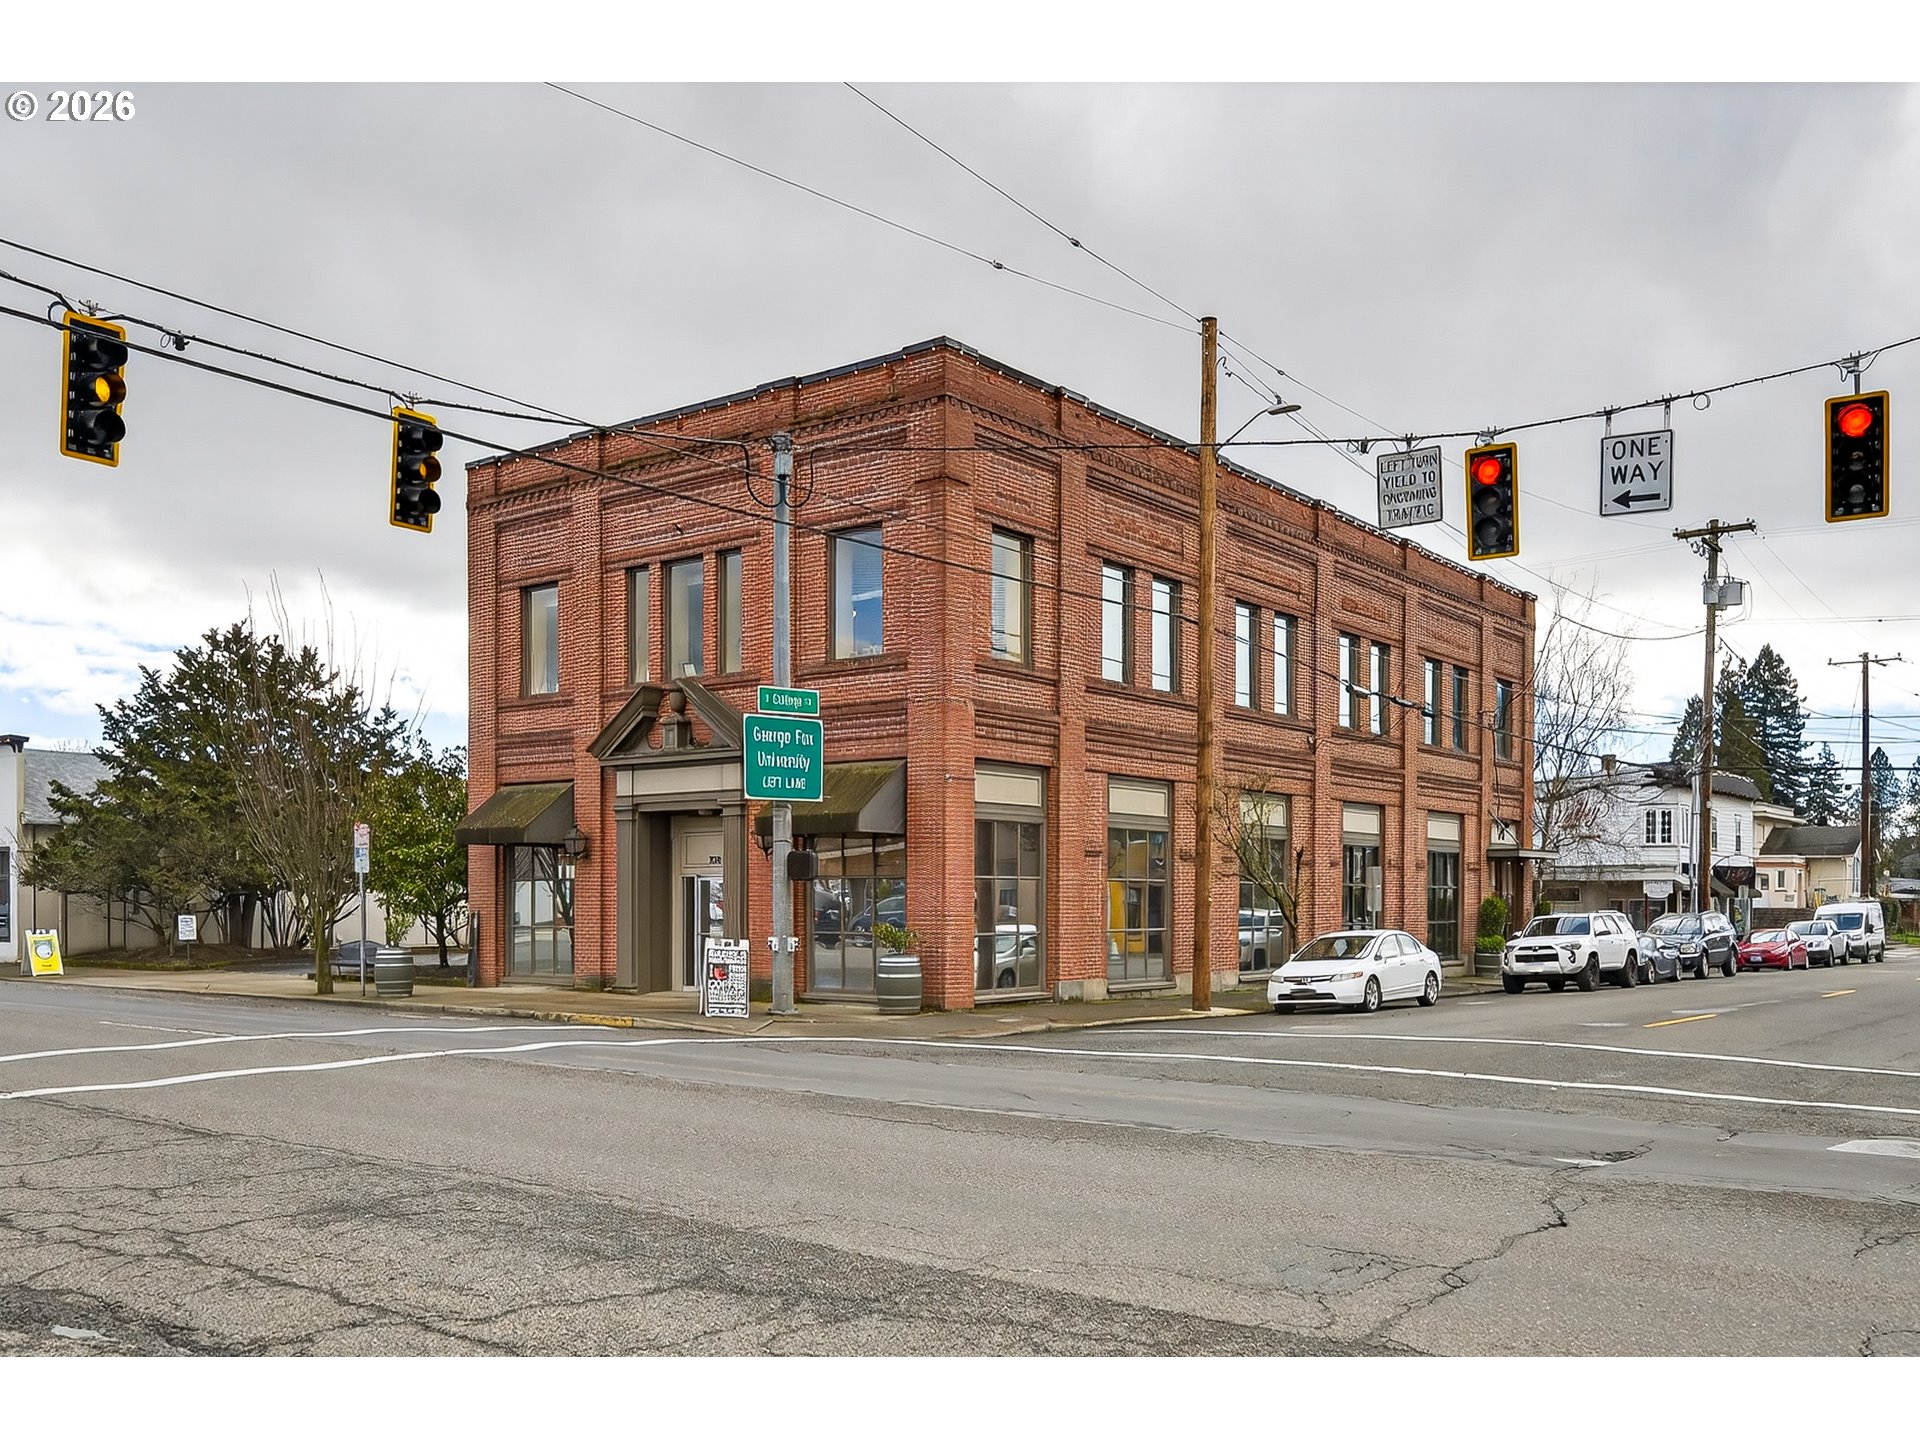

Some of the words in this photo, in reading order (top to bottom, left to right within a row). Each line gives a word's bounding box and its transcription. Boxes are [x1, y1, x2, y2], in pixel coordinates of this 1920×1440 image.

[1612, 436, 1661, 460] ONE
[1381, 460, 1405, 474] LEFT
[1412, 453, 1438, 469] TURN
[1610, 460, 1664, 485] WAY
[1383, 474, 1416, 489] YIELD
[1422, 470, 1436, 484] TO
[753, 726, 791, 748] George
[795, 729, 814, 746] Fox
[757, 751, 811, 773] University
